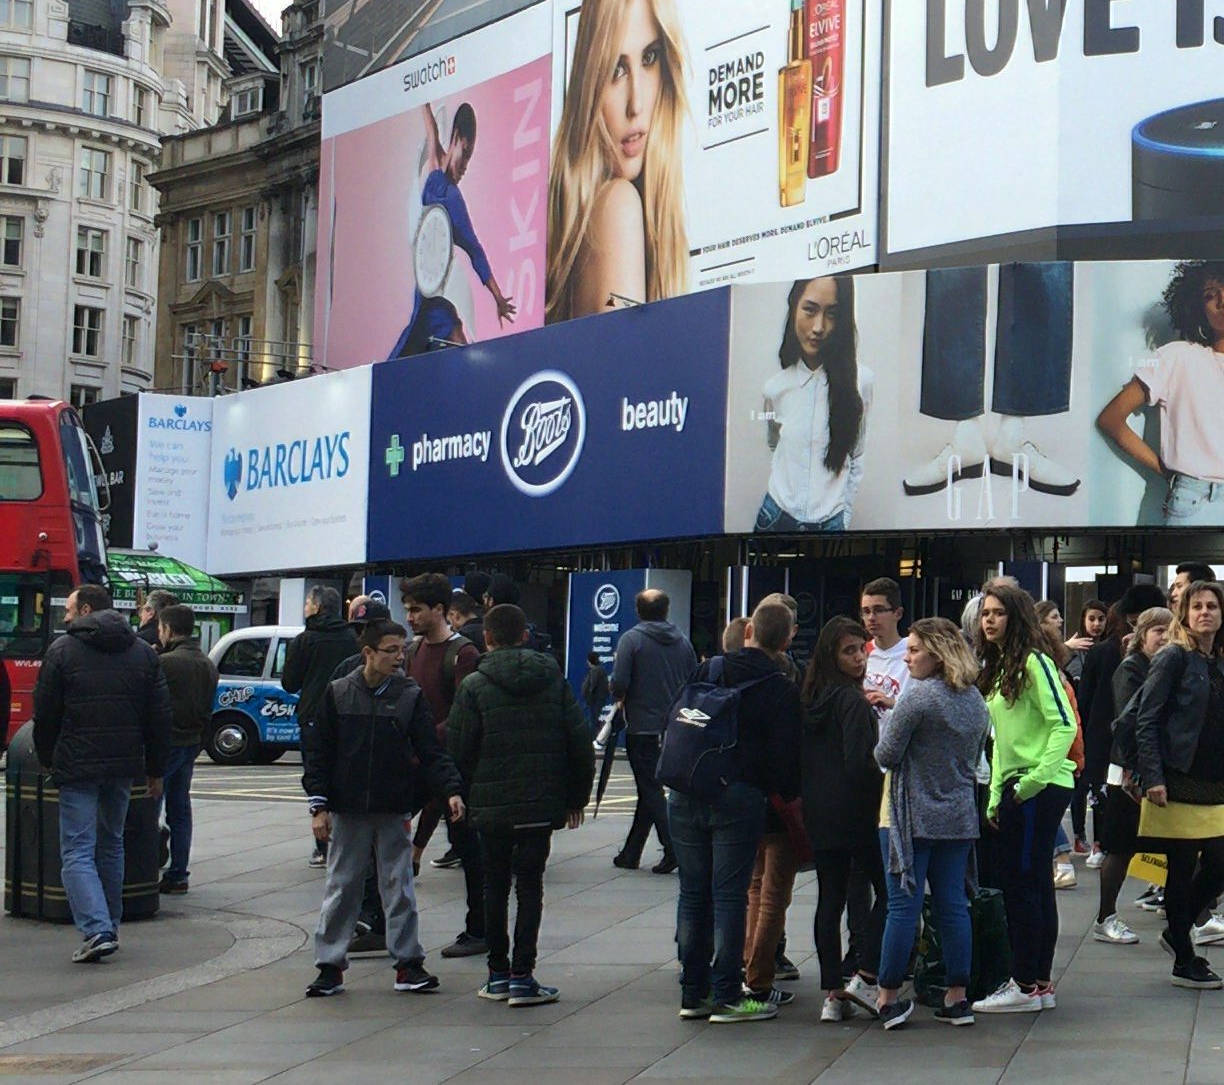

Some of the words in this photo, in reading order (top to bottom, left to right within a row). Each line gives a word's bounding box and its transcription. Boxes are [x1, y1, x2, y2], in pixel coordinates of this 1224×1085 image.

[809, 15, 841, 38] ELVIVE
[403, 56, 451, 92] swatch
[709, 51, 765, 85] DEMAND
[708, 72, 764, 116] MORE
[708, 116, 723, 129] FOR
[724, 107, 744, 125] YOUR
[745, 102, 764, 118] HAIR
[508, 77, 543, 315] SKIN
[808, 229, 872, 262] L'ORÉAL
[827, 255, 851, 268] PARIS
[1137, 358, 1160, 368] am
[149, 417, 213, 432] BARCLAYS
[621, 390, 689, 433] beauty
[513, 396, 572, 467] Boots
[247, 431, 350, 491] BARCLAYS
[412, 429, 493, 471] pharmacy
[947, 453, 1031, 521] GAP
[182, 592, 194, 601] IN
[218, 686, 255, 707] CHIP
